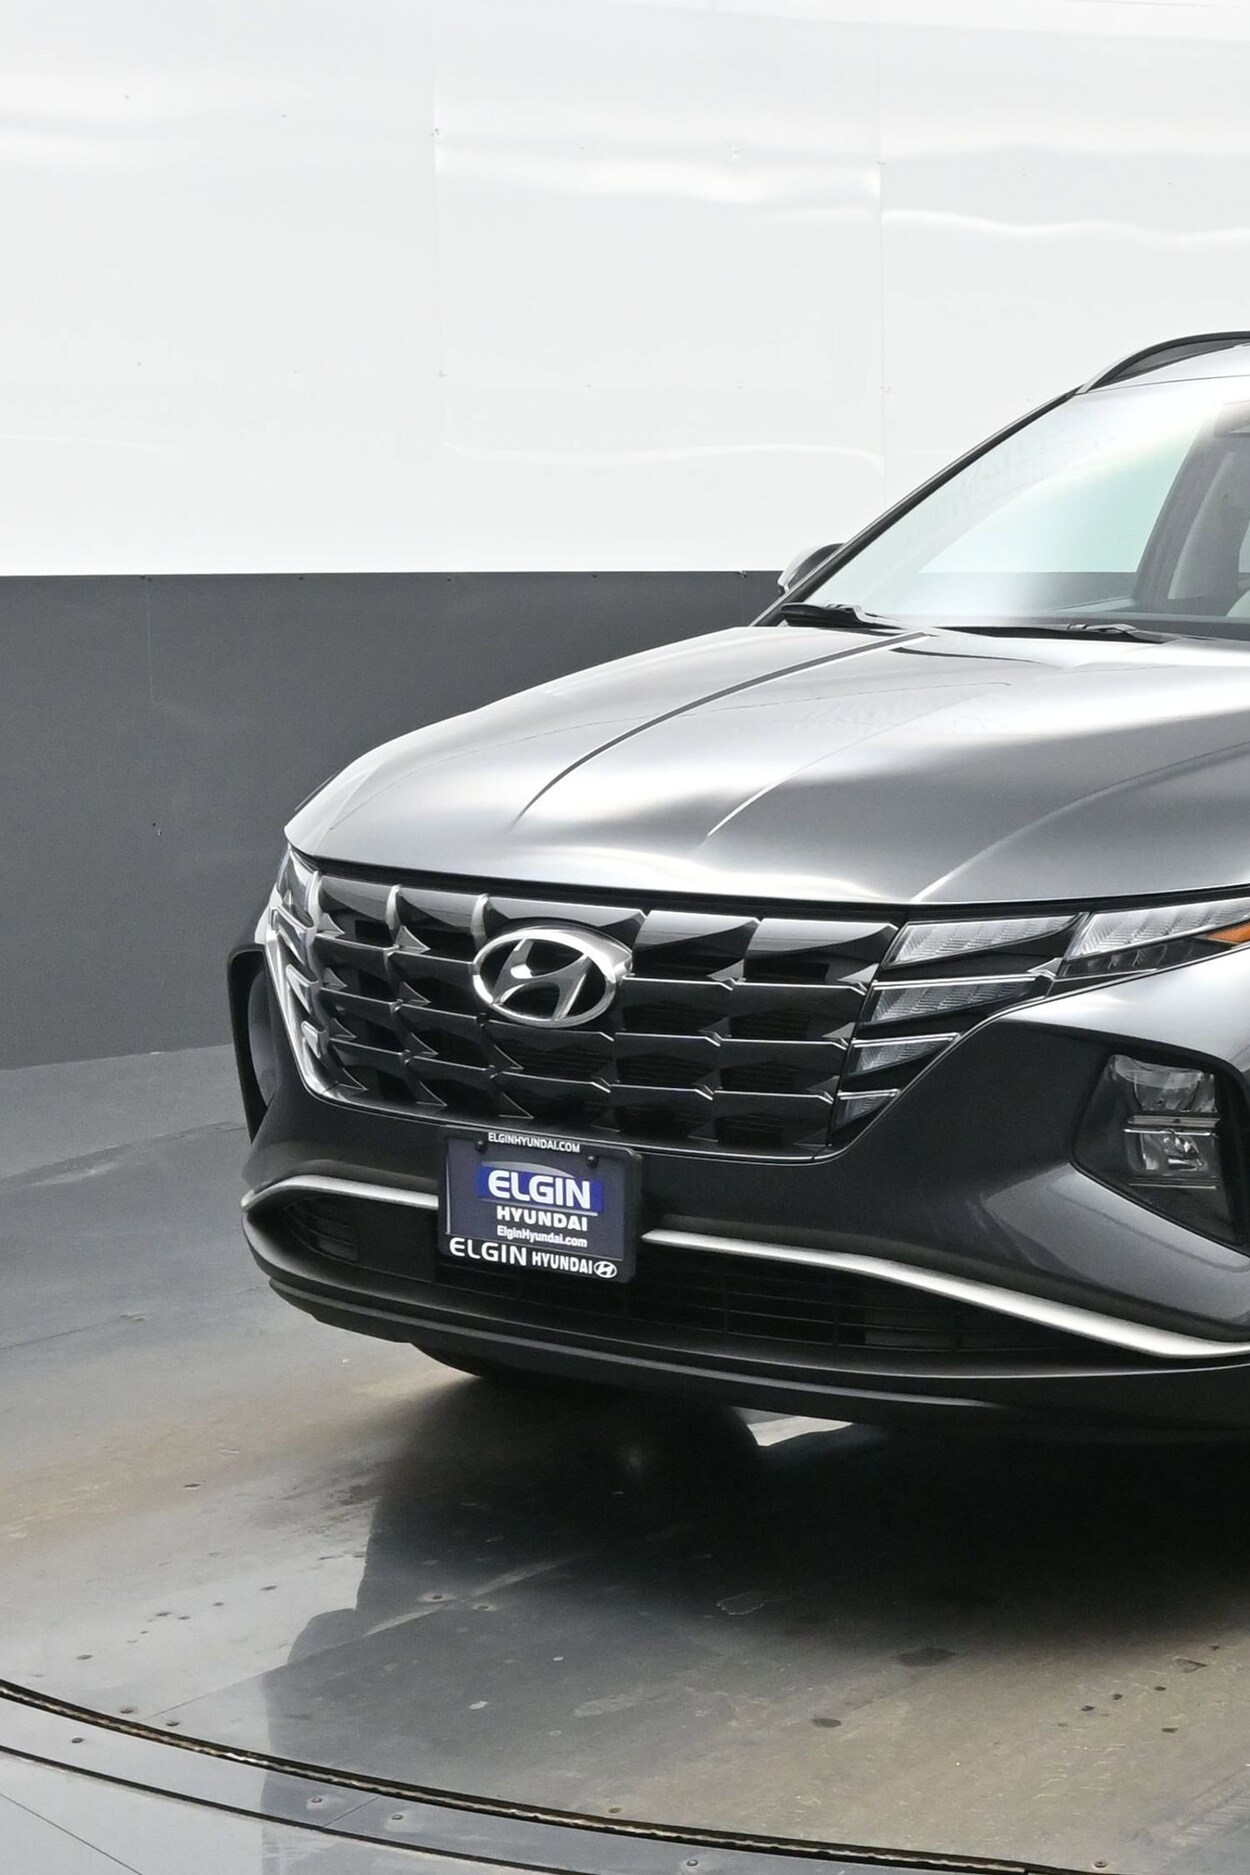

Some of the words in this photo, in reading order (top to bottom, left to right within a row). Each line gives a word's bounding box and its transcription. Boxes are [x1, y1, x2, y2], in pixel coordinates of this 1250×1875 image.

[488, 1132, 580, 1153] ELGINHYUNDAI.COM
[488, 1169, 591, 1210] ELGIN
[496, 1205, 588, 1231] HYUNDAI
[496, 1225, 588, 1248] ElginHyundai.com
[449, 1237, 527, 1266] ELGIN
[532, 1251, 593, 1275] HYUNDAI
